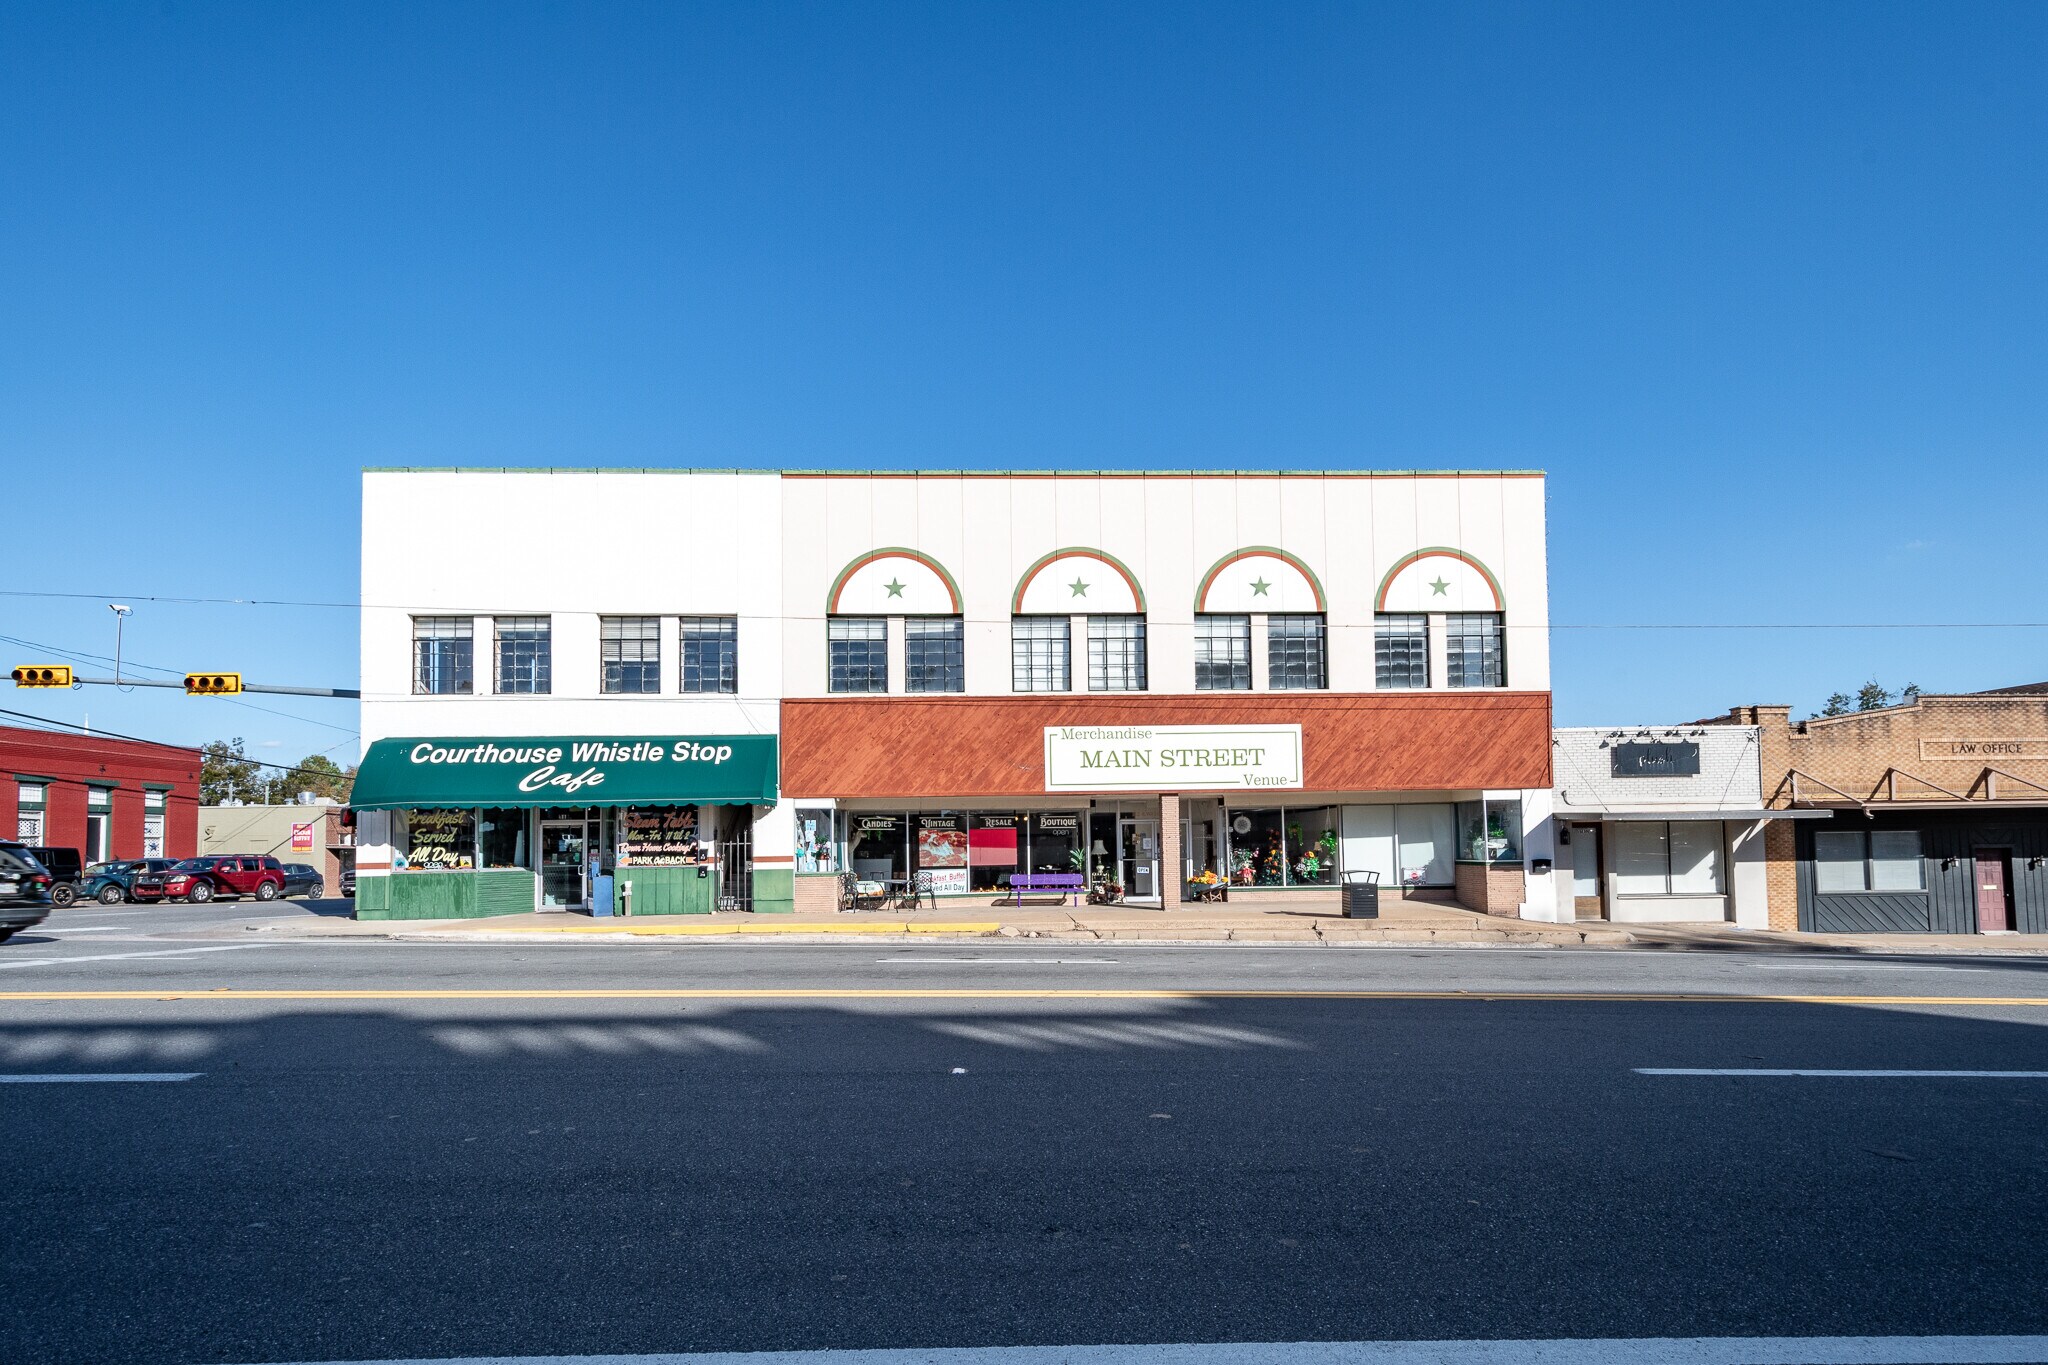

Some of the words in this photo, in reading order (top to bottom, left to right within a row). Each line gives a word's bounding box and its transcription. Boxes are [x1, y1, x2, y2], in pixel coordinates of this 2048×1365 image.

[1060, 727, 1153, 740] Merchandise
[410, 742, 562, 764] Courthouse
[572, 741, 664, 762] Whistle
[671, 741, 732, 765] Stop
[1951, 744, 1976, 753] LAW
[1982, 743, 2022, 753] OFFICE
[1080, 750, 1152, 768] MAIN
[1160, 748, 1266, 768] STREET
[518, 765, 606, 793] Cafe
[1243, 774, 1288, 786] Venue
[407, 810, 466, 829] Breakfast
[623, 813, 660, 828] Steam
[663, 811, 695, 828] Table
[1040, 817, 1077, 827] BOUTIQUE
[413, 827, 458, 843] Served
[408, 846, 432, 862] All
[432, 846, 459, 867] Day
[633, 857, 653, 865] PARK
[666, 856, 686, 864] BACK
[949, 872, 966, 881] Buffet
[944, 883, 953, 891] All
[953, 883, 965, 893] Day
